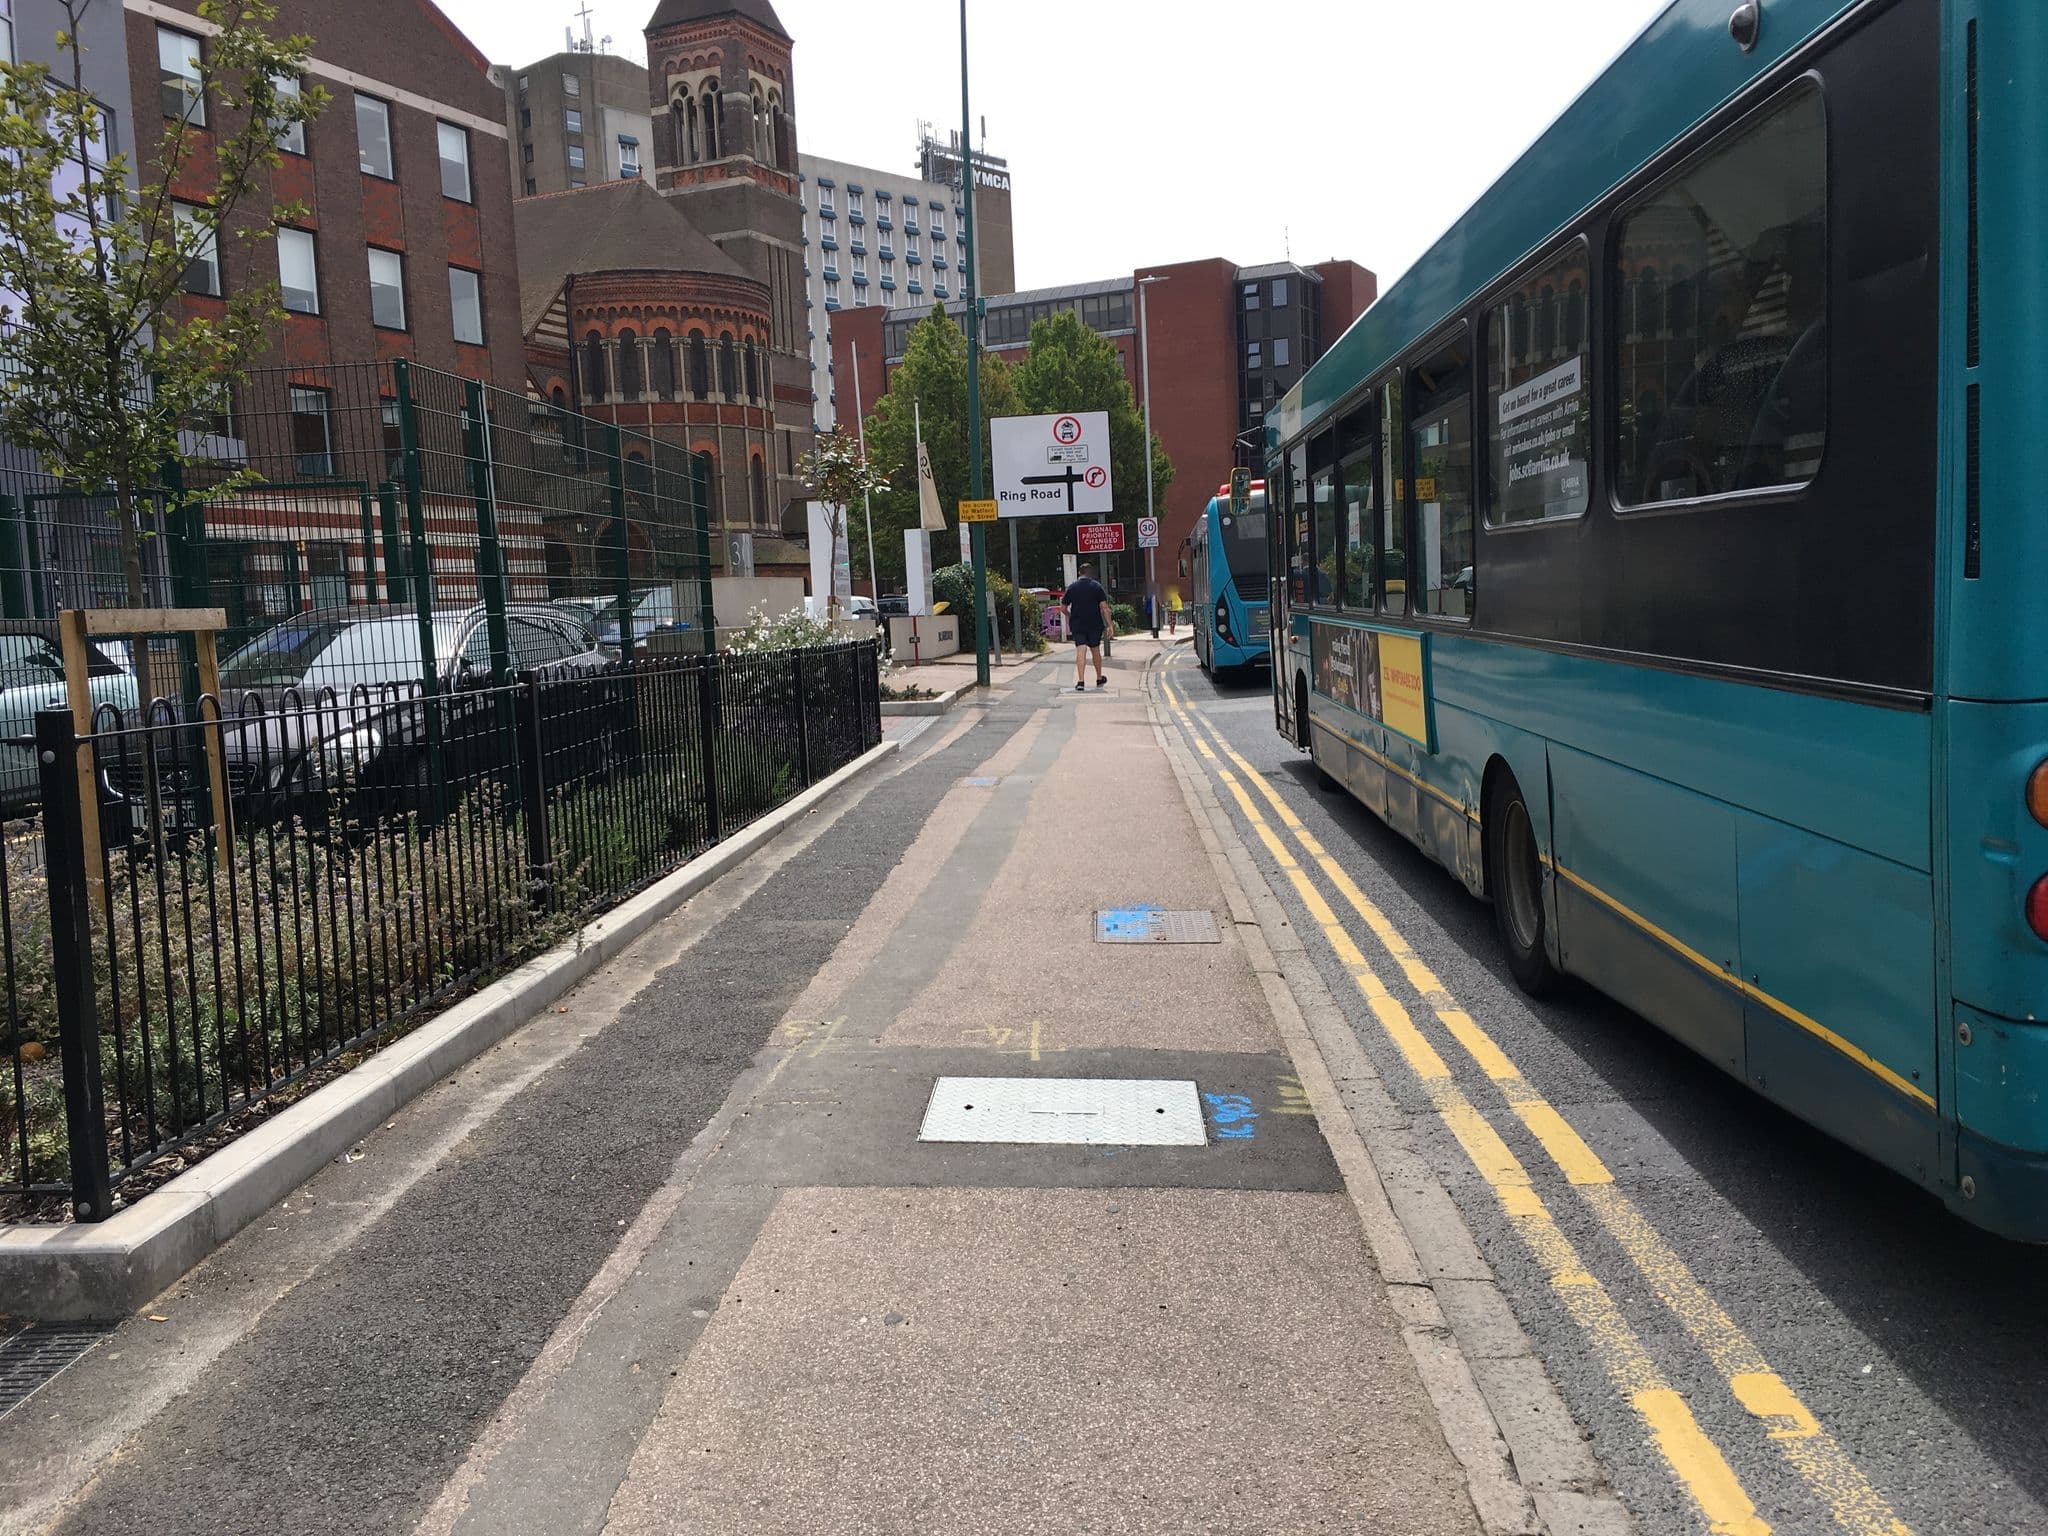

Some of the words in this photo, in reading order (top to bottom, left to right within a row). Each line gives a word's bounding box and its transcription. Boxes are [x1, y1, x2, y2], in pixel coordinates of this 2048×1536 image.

[974, 170, 1010, 191] YMCA
[1517, 390, 1530, 408] board
[1543, 378, 1557, 400] great
[1000, 490, 1026, 502] Ring
[1031, 488, 1061, 499] Road
[1082, 531, 1120, 539] PRIORITIES
[1143, 524, 1154, 532] 30
[1084, 537, 1118, 545] CHANGED
[731, 541, 741, 566] 3
